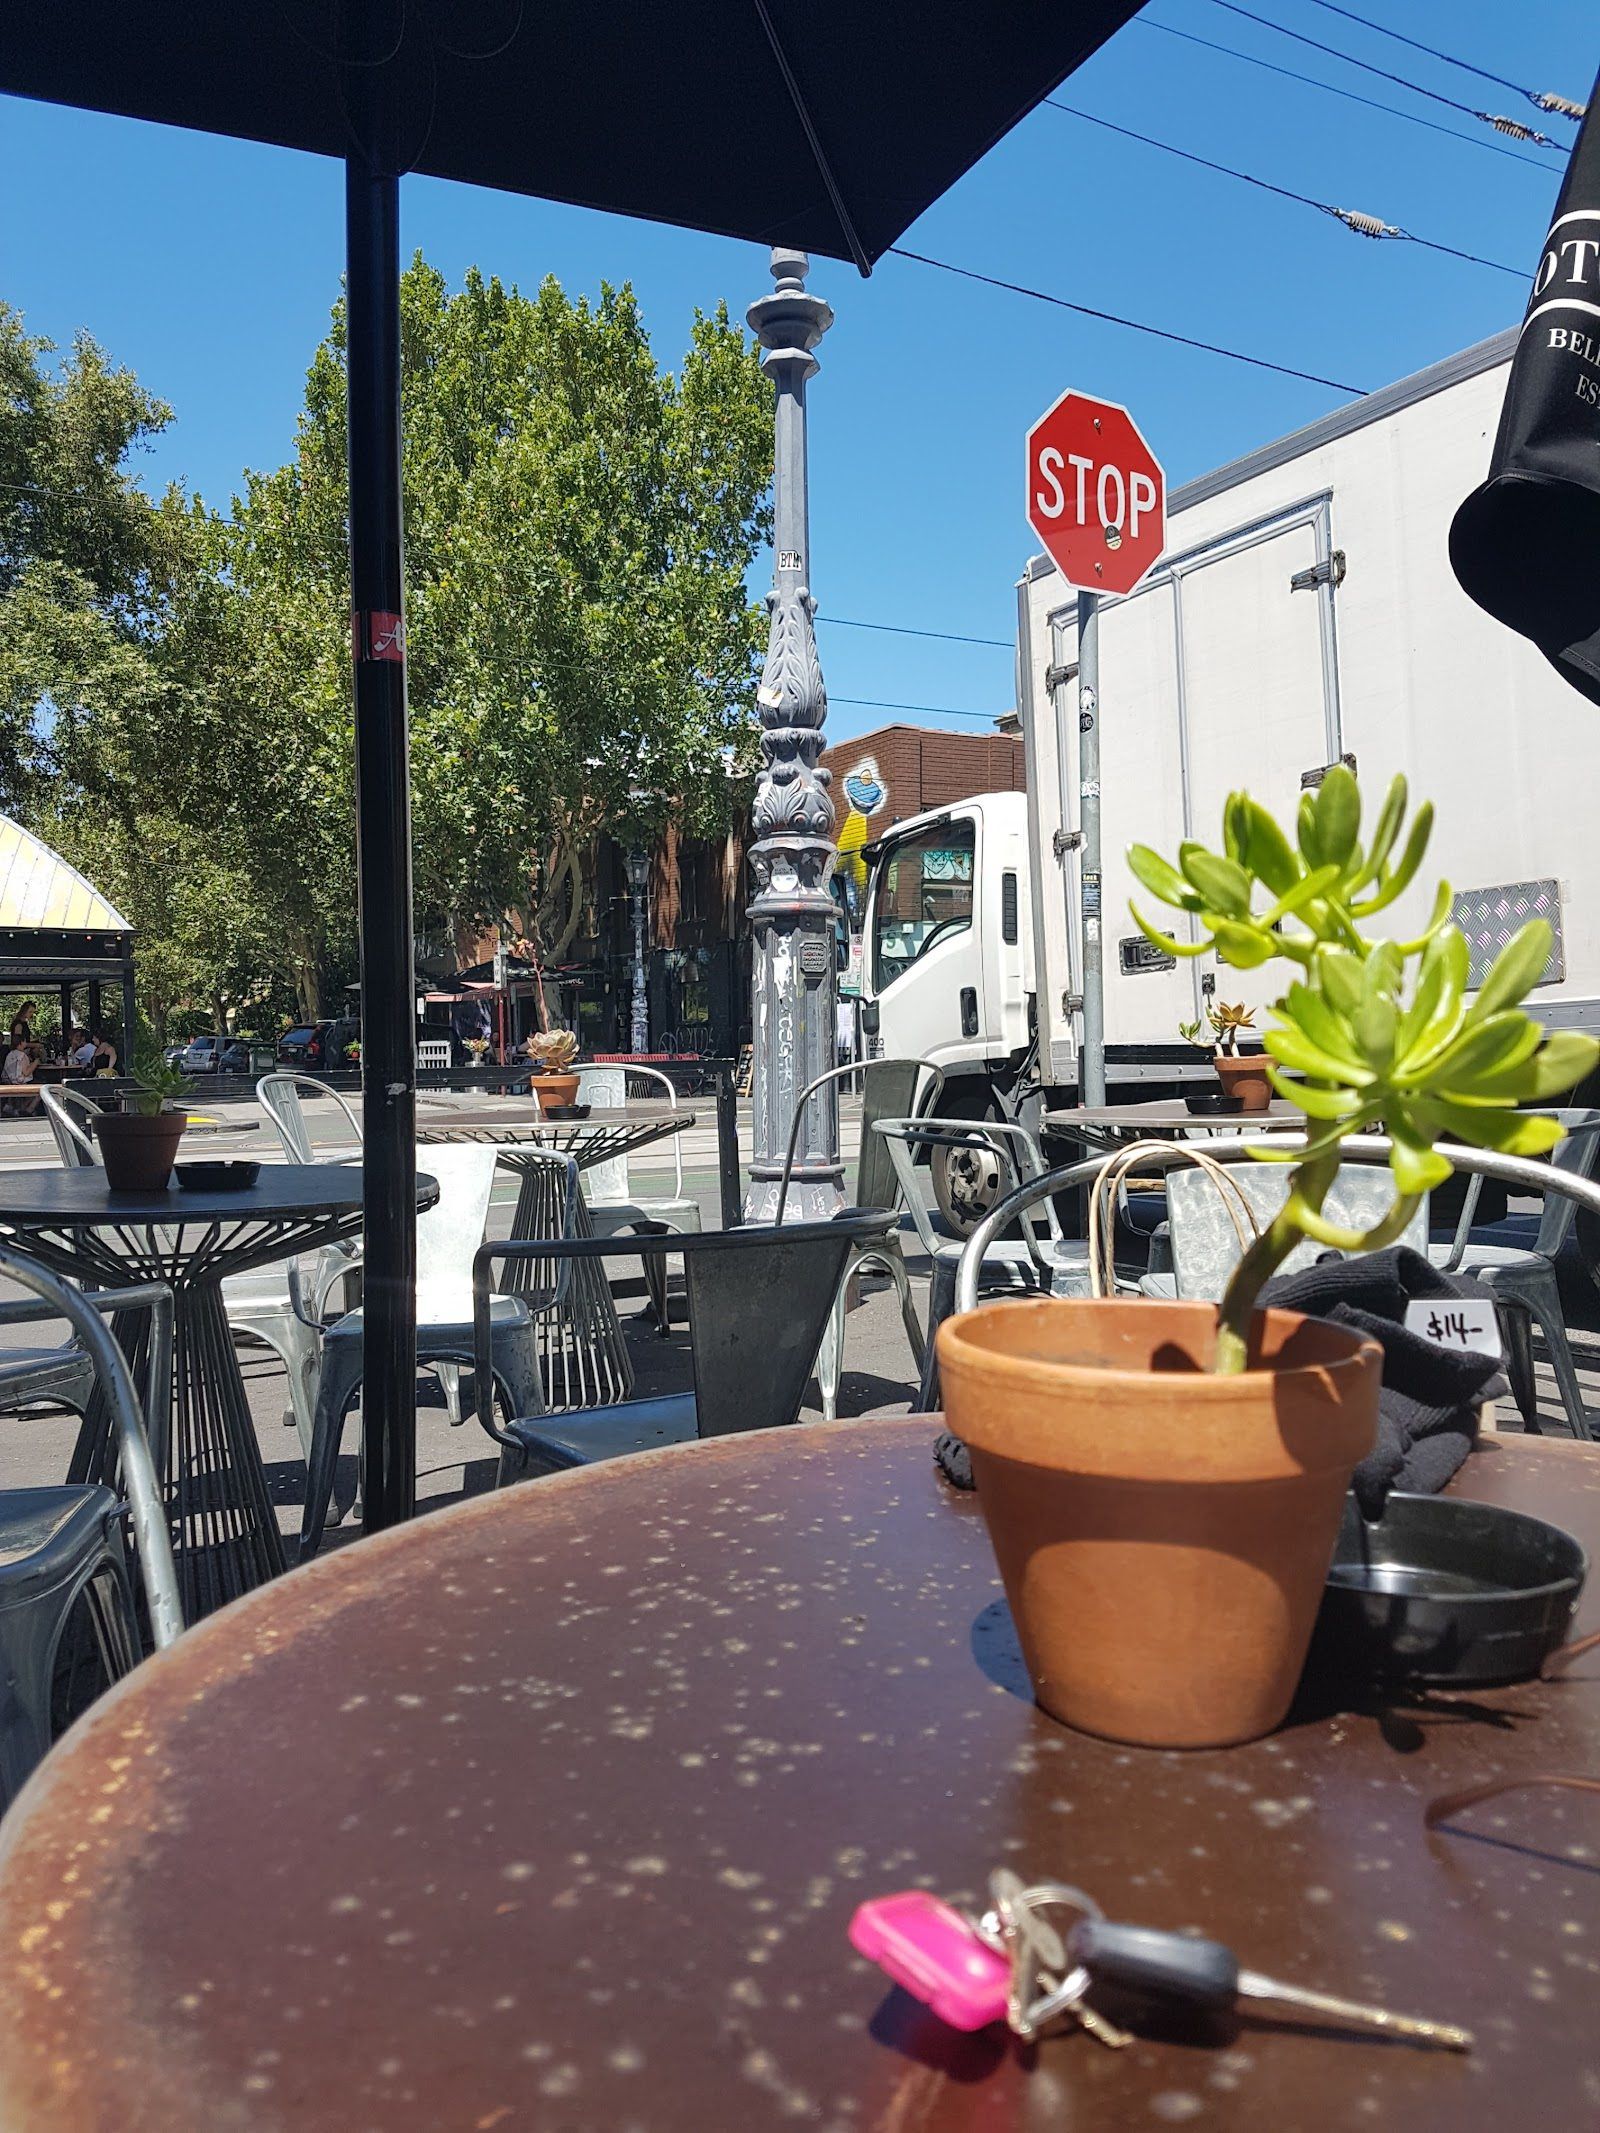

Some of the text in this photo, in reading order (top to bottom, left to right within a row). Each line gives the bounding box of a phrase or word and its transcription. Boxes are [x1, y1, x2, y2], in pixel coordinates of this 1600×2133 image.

[1530, 240, 1600, 304] OT
[1547, 328, 1600, 367] BEL
[1037, 446, 1156, 538] STOP
[1426, 1311, 1483, 1345] $14-
